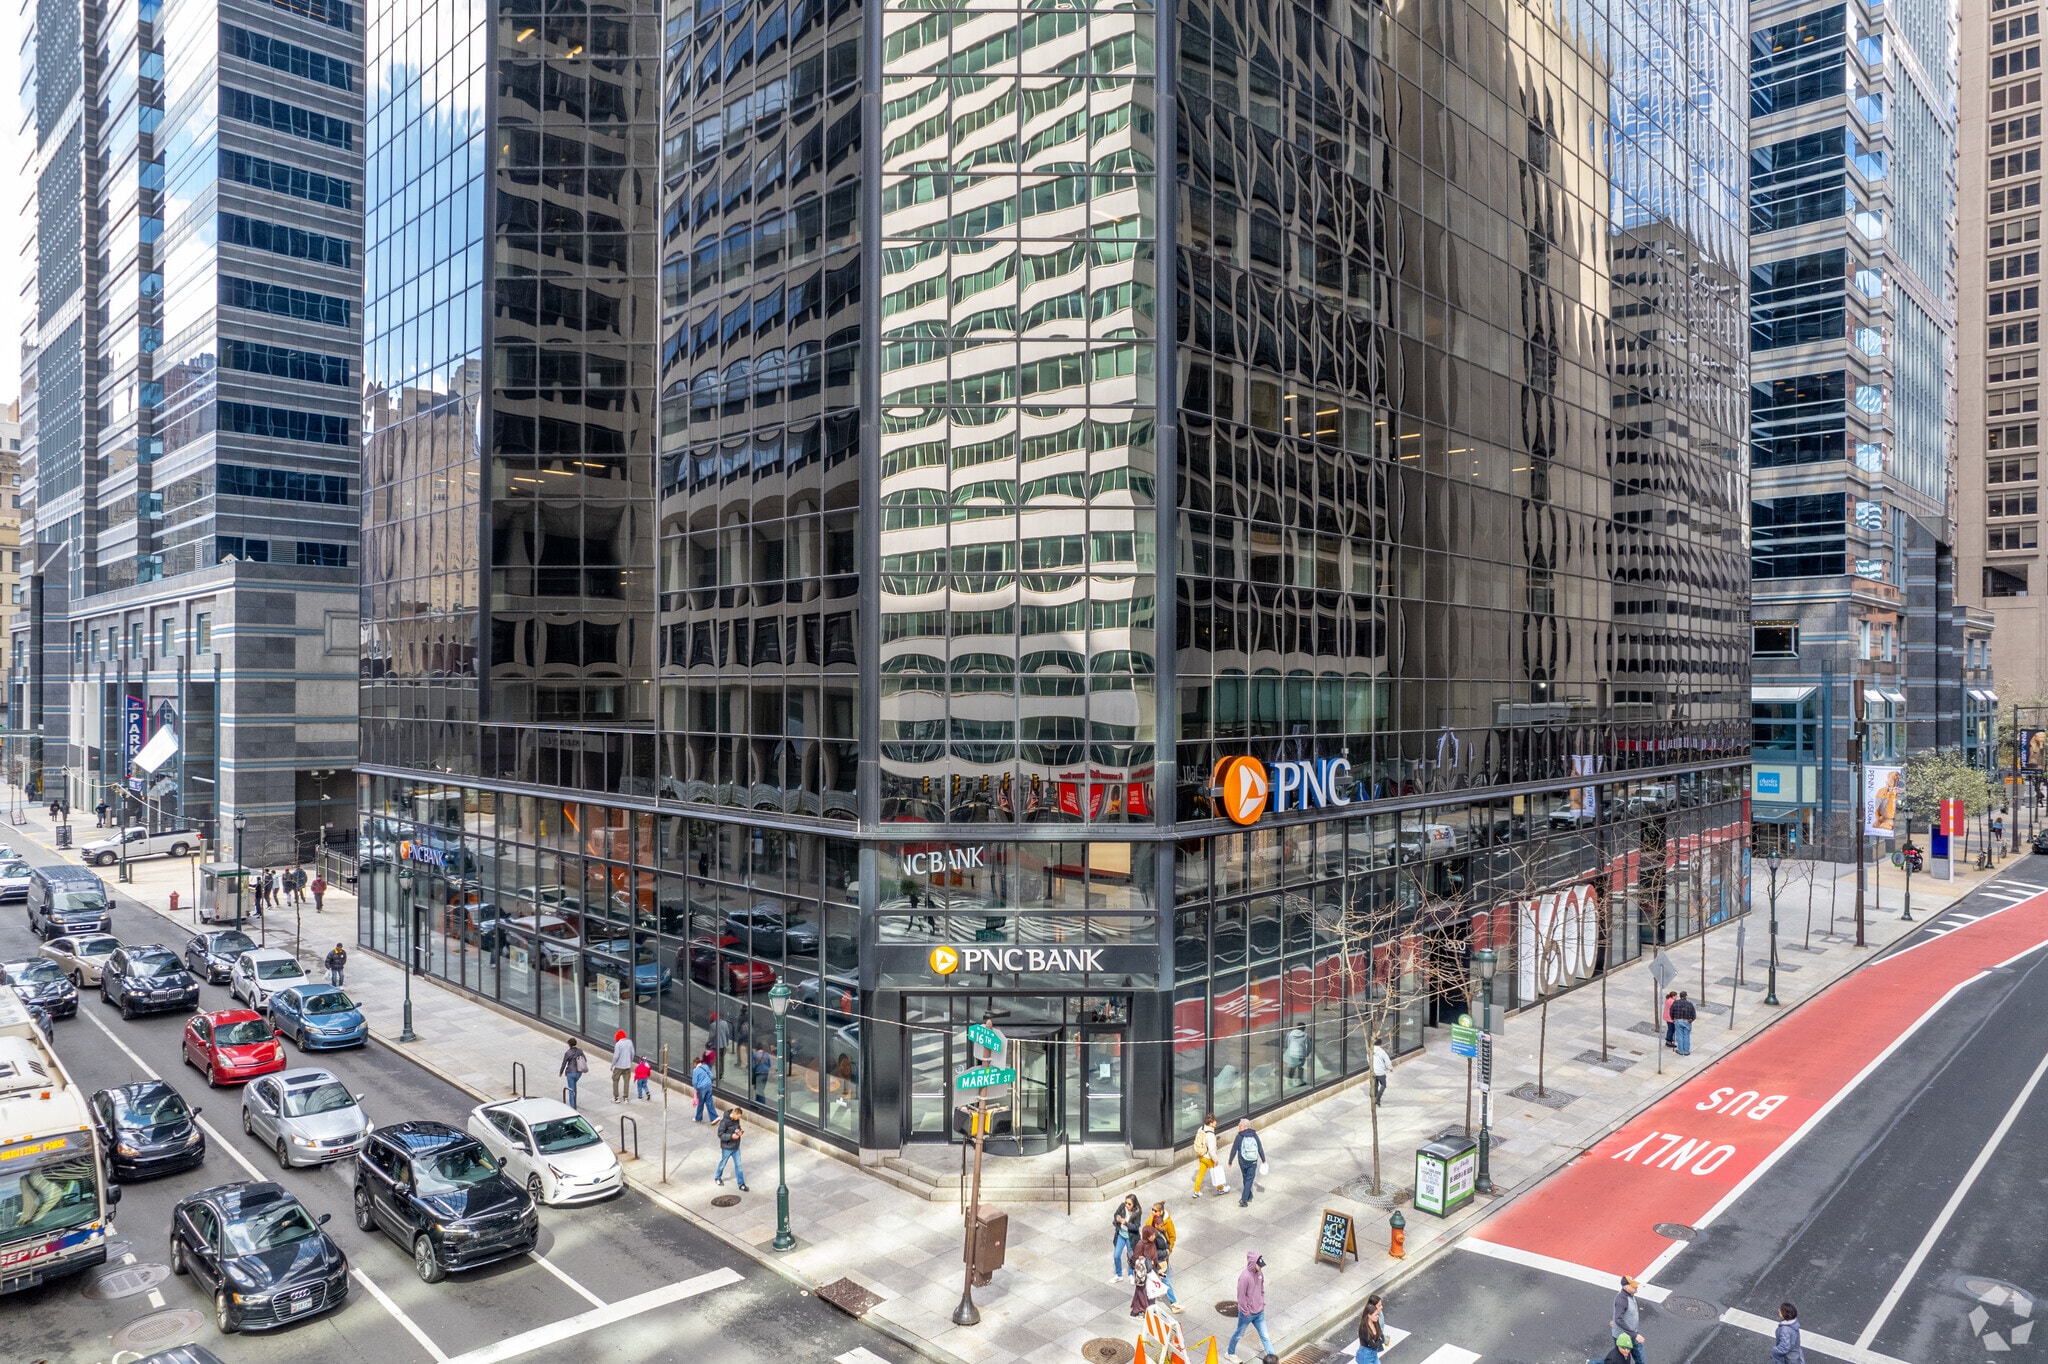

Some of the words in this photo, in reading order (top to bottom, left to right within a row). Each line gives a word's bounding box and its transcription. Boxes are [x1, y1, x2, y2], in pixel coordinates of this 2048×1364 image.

[129, 713, 141, 755] PARK
[1270, 758, 1351, 813] PNC
[1867, 769, 1875, 790] PENN
[409, 843, 425, 861] PNC
[424, 847, 445, 866] BANK
[928, 846, 984, 873] BANK
[1520, 884, 1599, 1001] 1600
[962, 949, 1023, 971] PNC
[1026, 949, 1104, 971] BANK
[993, 1043, 1000, 1052] ST
[962, 1073, 1001, 1088] MARKET
[1003, 1074, 1011, 1083] ST
[1695, 1087, 1789, 1121] BUS
[43, 1138, 66, 1151] PARK
[1611, 1131, 1736, 1176] ONLY
[1322, 1236, 1342, 1248] Coffee
[0, 1244, 48, 1265] SEPTA
